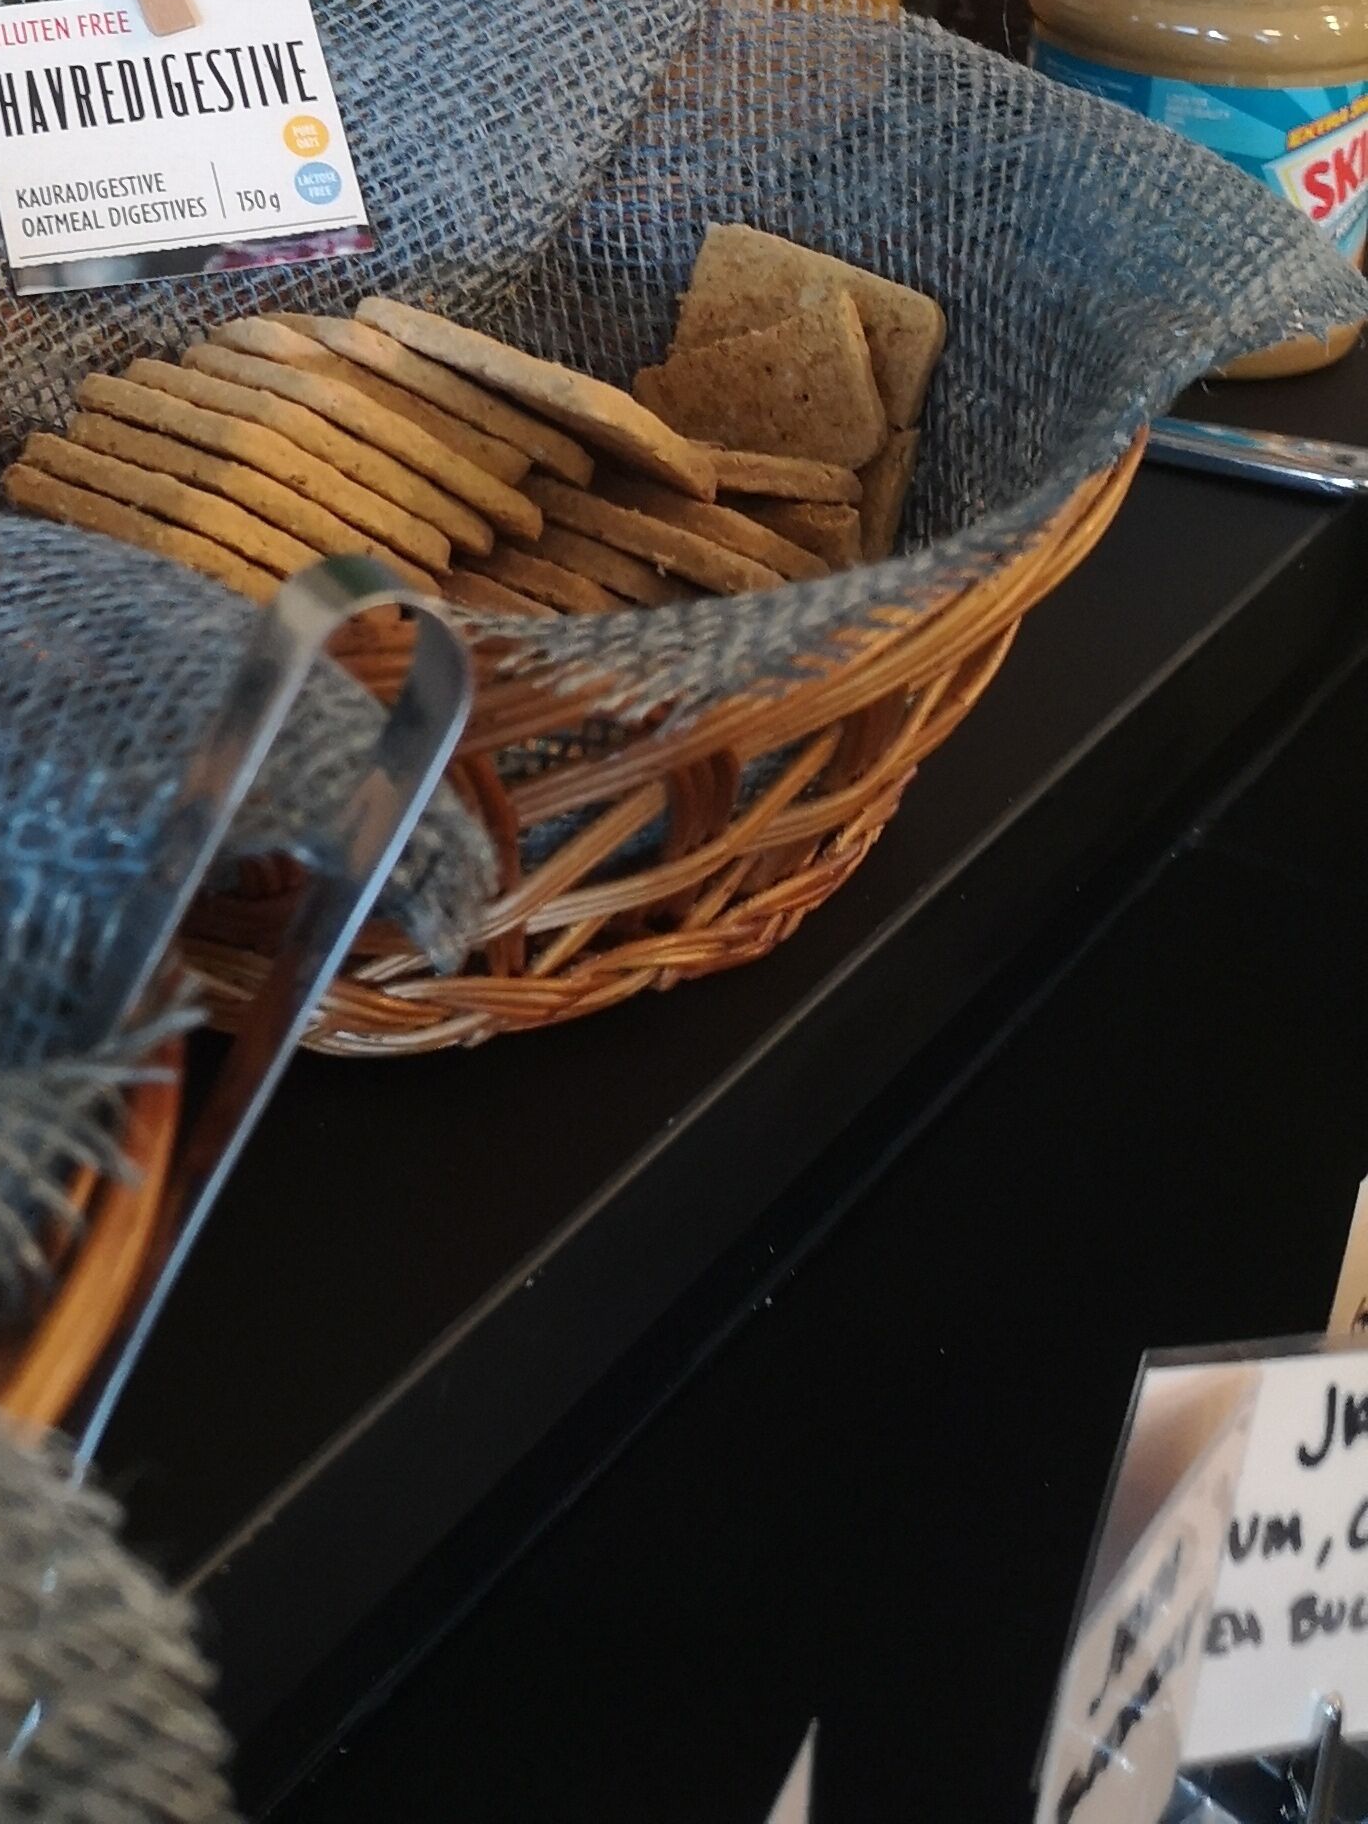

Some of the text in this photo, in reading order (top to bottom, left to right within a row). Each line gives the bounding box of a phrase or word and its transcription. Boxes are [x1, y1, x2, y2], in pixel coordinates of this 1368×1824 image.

[77, 9, 133, 38] FREE
[14, 172, 168, 210] KAURADIGESTIVE
[236, 189, 267, 213] 150
[21, 196, 209, 239] OATMEAL DIGESTIVES
